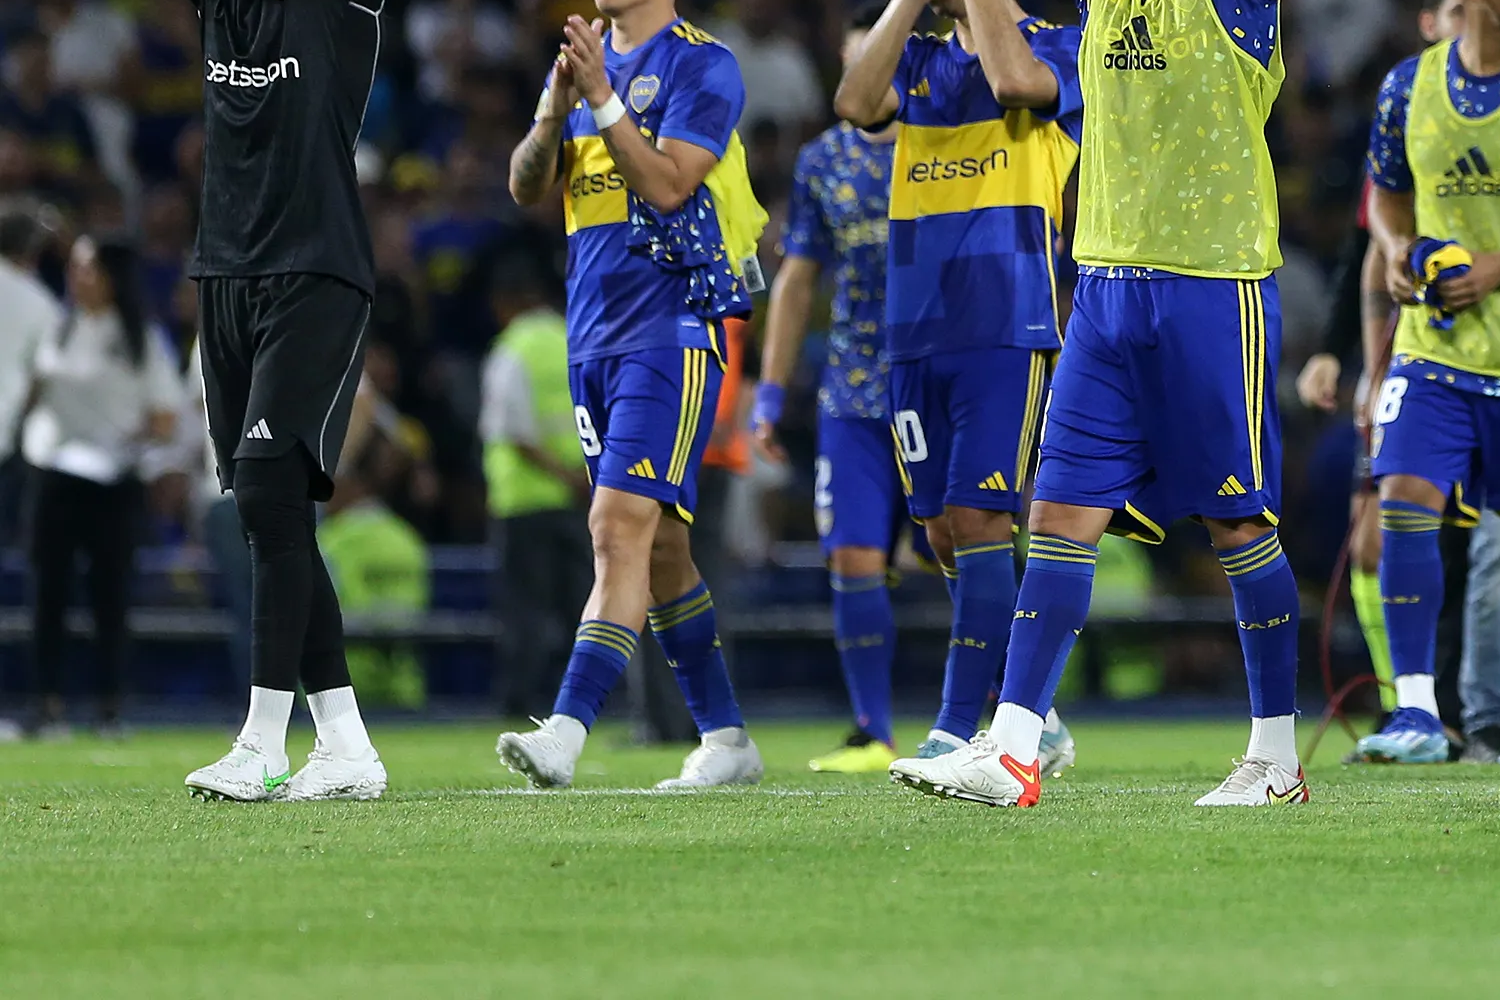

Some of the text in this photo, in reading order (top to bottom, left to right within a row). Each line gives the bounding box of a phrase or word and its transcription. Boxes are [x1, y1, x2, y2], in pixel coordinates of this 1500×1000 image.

[1103, 48, 1167, 70] adidas
[574, 404, 603, 457] 9
[894, 408, 929, 463] 0
